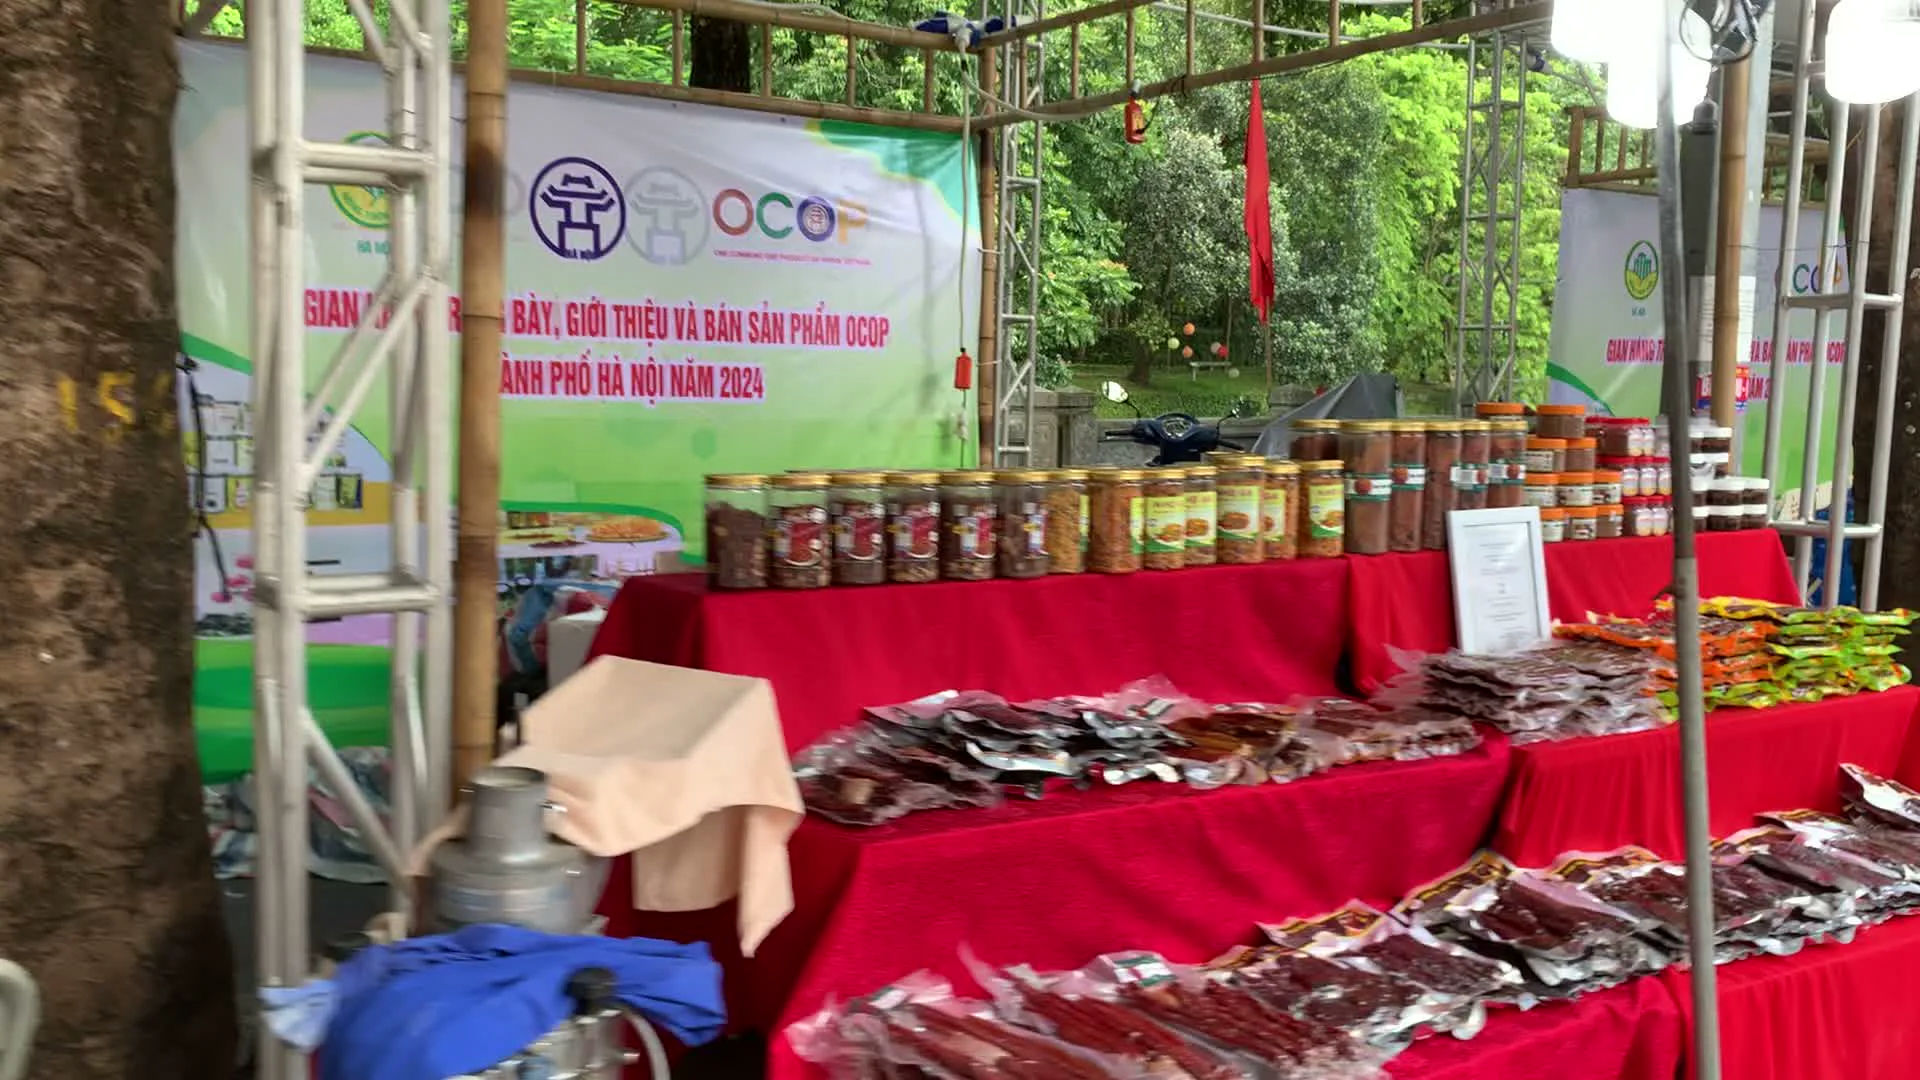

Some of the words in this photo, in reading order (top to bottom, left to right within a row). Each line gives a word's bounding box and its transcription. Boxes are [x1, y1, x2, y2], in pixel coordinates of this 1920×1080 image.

[712, 188, 868, 244] OCOP
[304, 289, 359, 328] GIAN
[512, 292, 560, 339] BÀY,
[566, 295, 607, 337] GIỚI
[612, 298, 668, 347] THIỆU
[674, 300, 699, 341] VÀ
[704, 302, 742, 343] BÁN
[749, 300, 785, 345] SẢN
[790, 301, 841, 346] PHẨM
[846, 315, 890, 347] OCOP
[500, 352, 543, 394] ÀNH
[550, 348, 591, 395] PHỐ
[597, 355, 625, 396] HÀ
[631, 356, 664, 404] NỘI
[671, 358, 714, 399] NĂM
[719, 366, 764, 399] 2024
